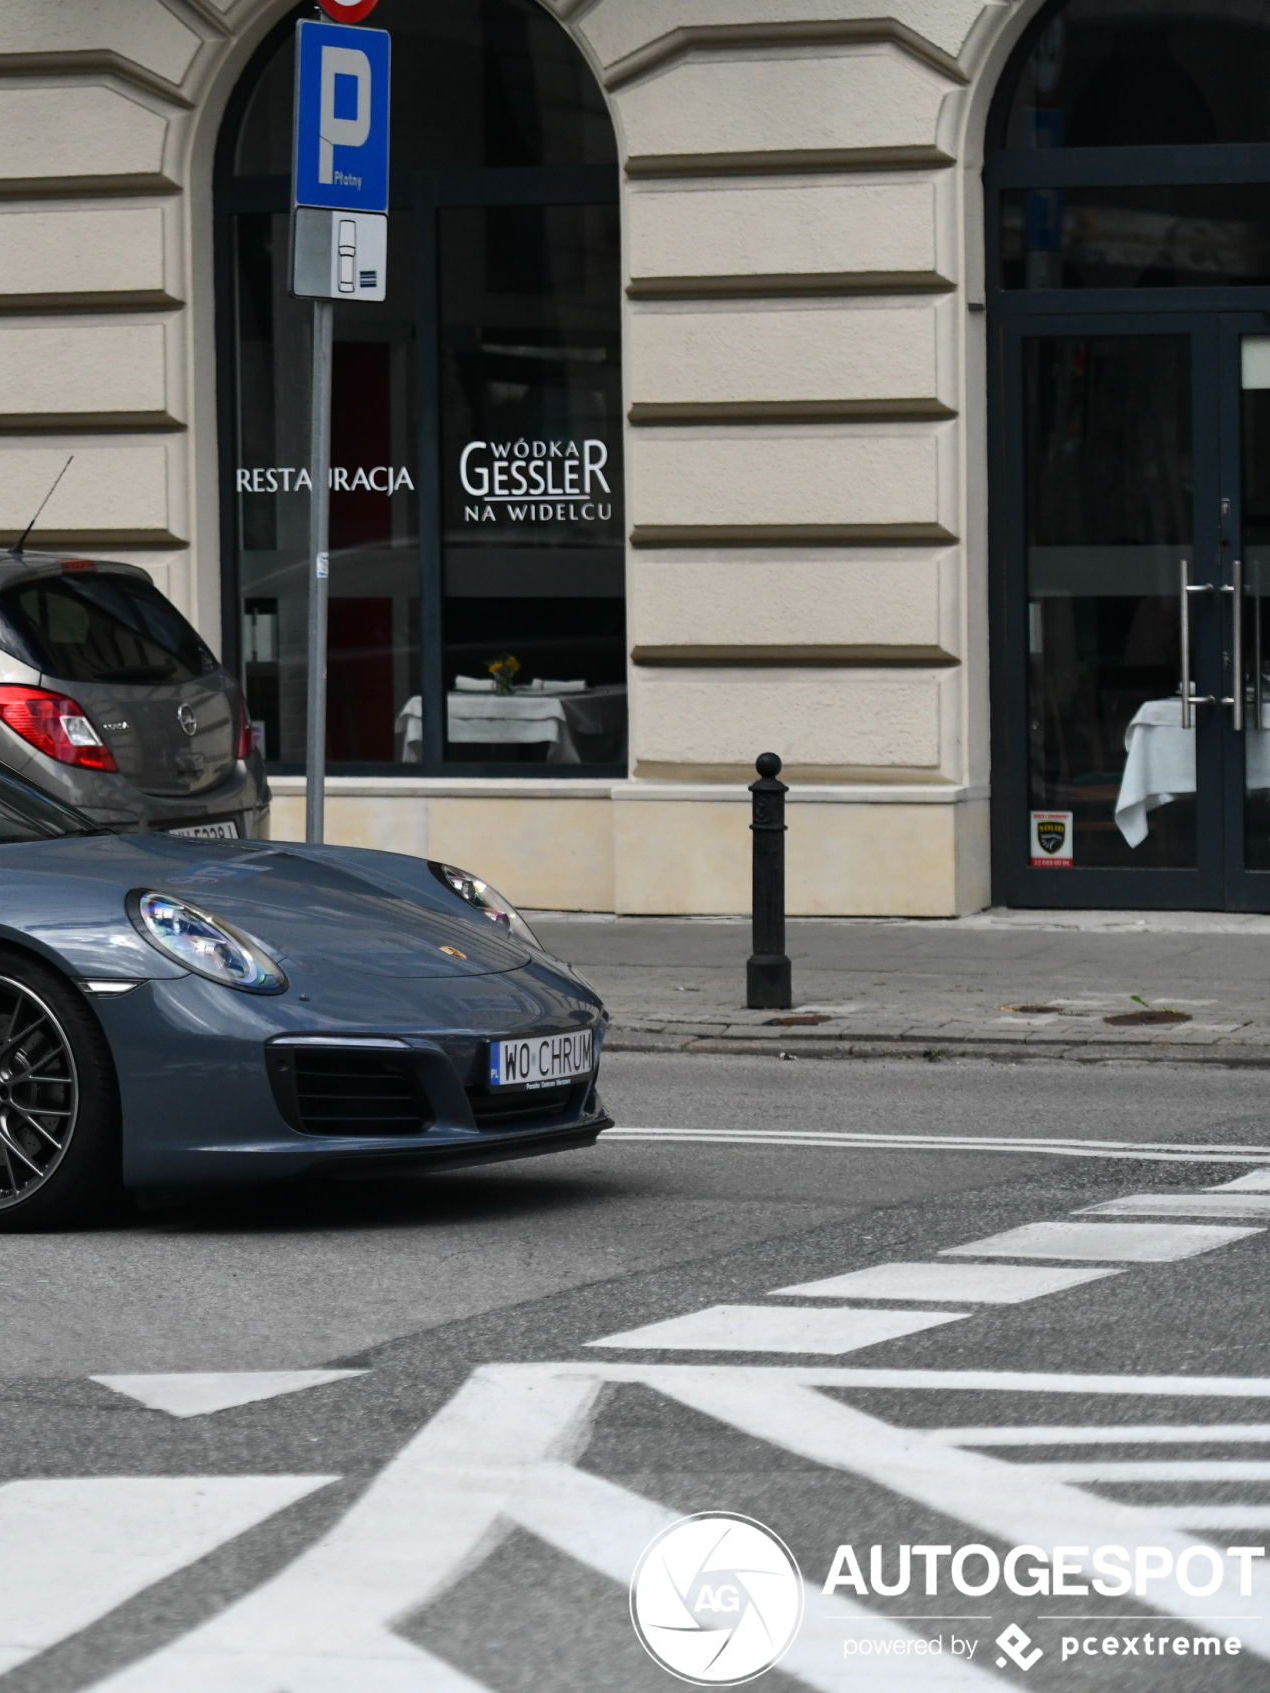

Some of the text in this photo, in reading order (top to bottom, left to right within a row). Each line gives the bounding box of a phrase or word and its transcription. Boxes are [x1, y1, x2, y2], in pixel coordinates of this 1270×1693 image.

[318, 45, 372, 185] P
[490, 437, 579, 458] WÓDKA
[236, 466, 415, 497] RESTARACJA
[464, 503, 612, 522] NA WIDELCU
[1039, 824, 1064, 833] SOLID
[505, 1033, 591, 1081] WO CHRUM
[490, 1069, 499, 1079] PL
